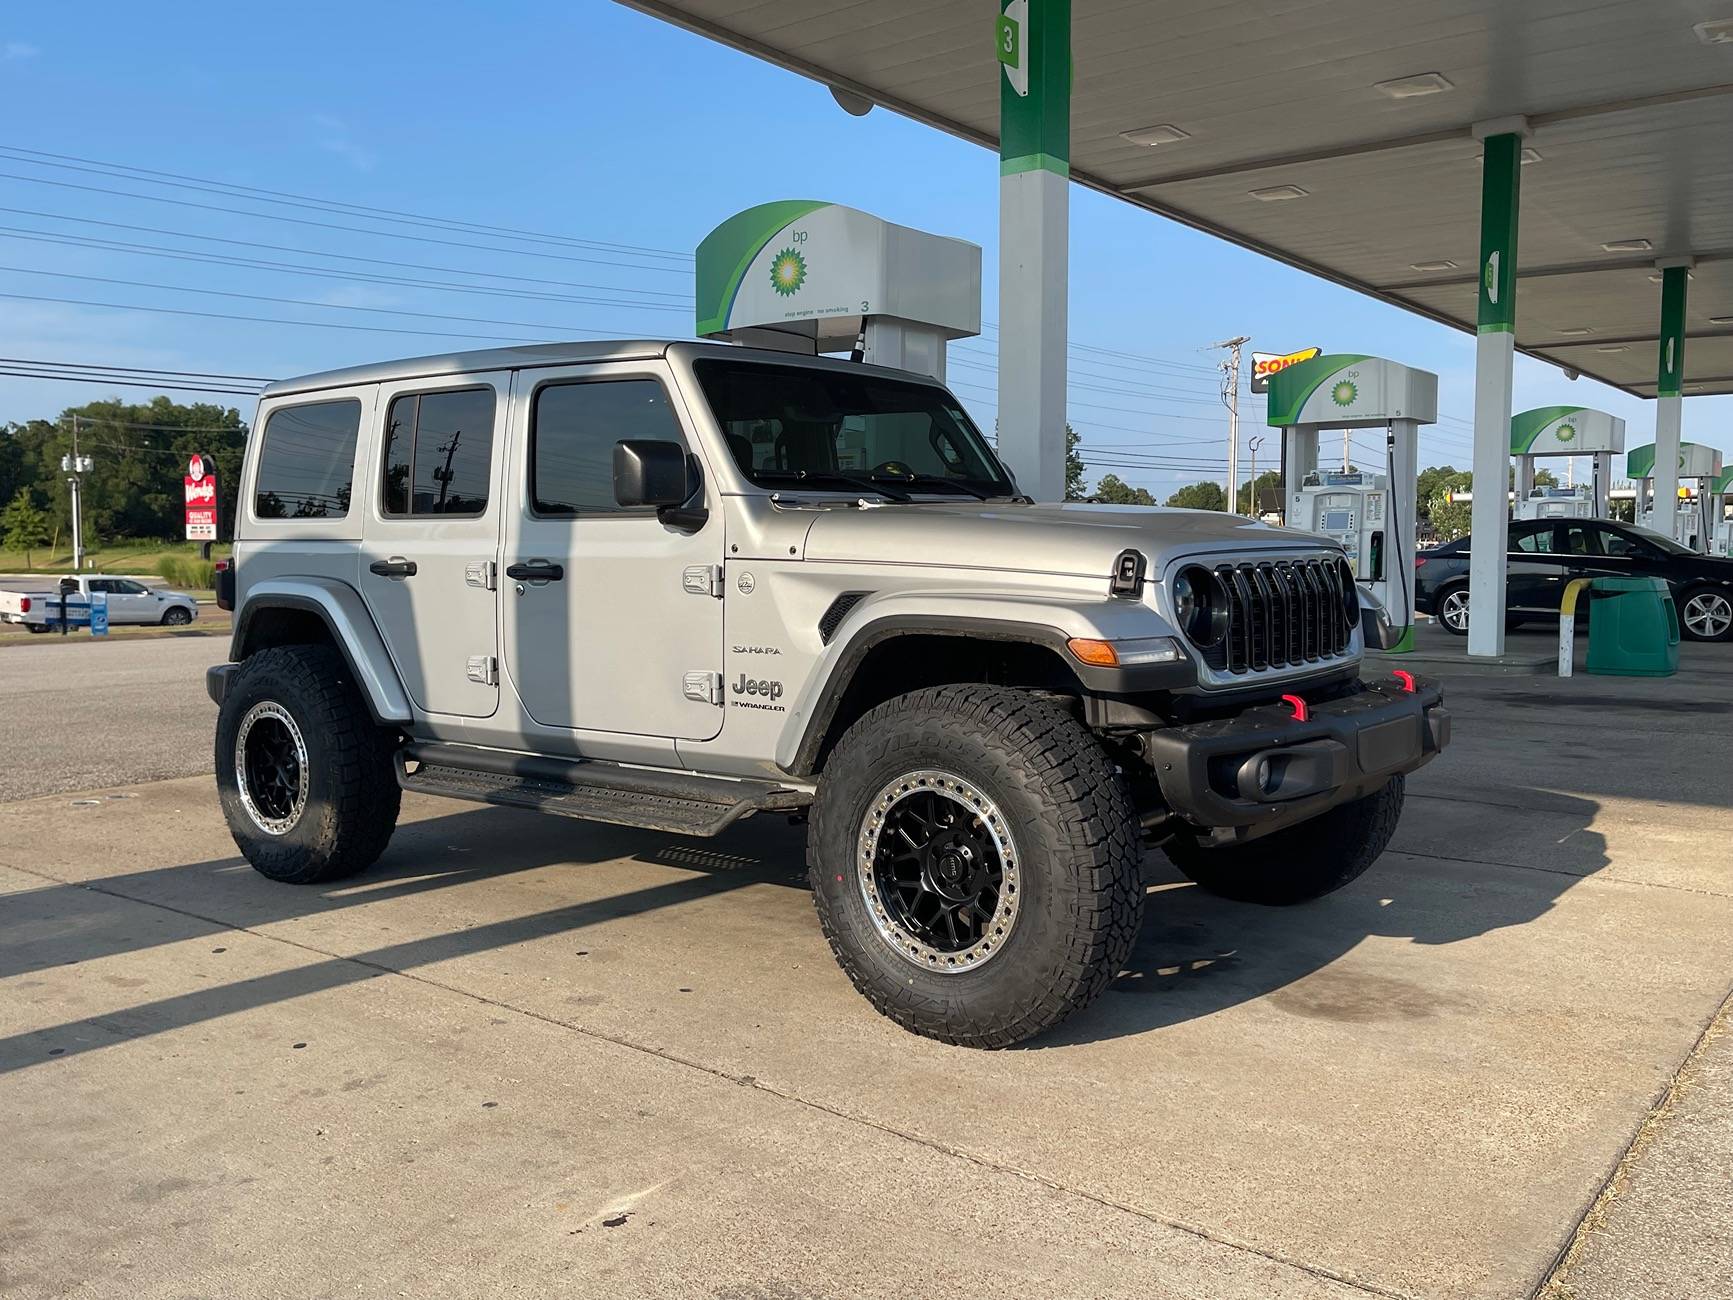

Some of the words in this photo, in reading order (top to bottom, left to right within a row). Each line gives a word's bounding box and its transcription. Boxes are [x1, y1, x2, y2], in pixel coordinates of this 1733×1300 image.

[1004, 25, 1013, 53] 3
[792, 229, 808, 245] bp
[861, 300, 870, 312] 3
[732, 645, 783, 655] SAHARA
[732, 673, 783, 701] Jeep
[739, 701, 785, 712] WRANGLER
